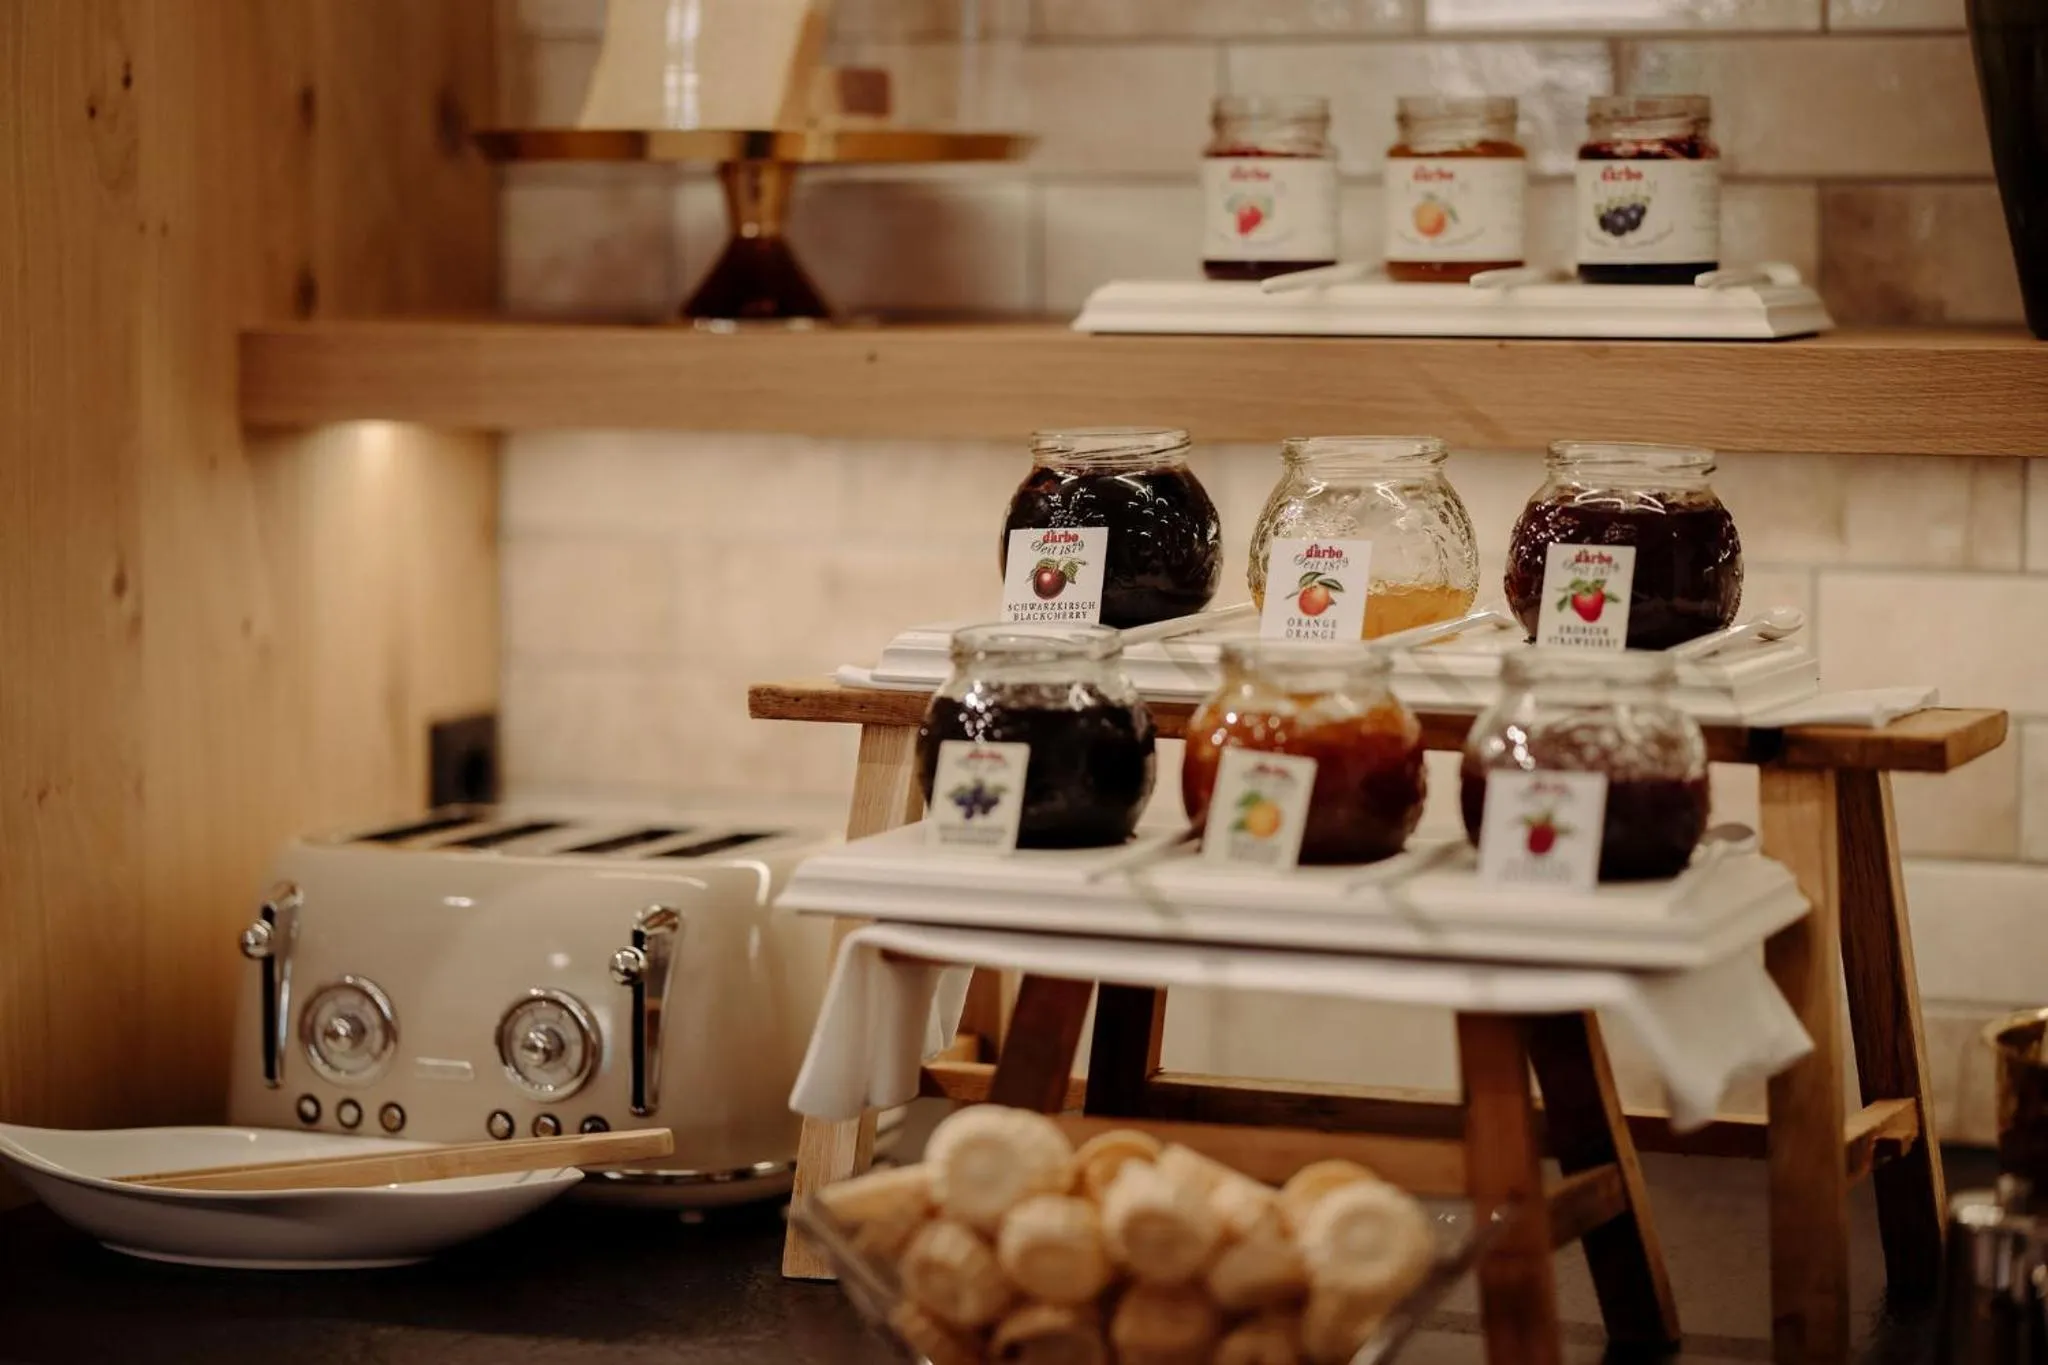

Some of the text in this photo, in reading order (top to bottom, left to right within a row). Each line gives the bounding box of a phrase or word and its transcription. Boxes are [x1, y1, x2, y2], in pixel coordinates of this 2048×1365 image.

[1030, 539, 1085, 555] Seit 1879
[1008, 601, 1096, 612] SCHWARZKIRSCH
[1013, 611, 1087, 621] BLACKCHERRY
[1287, 617, 1337, 629] ORANGE
[1285, 628, 1336, 640] ORANGE
